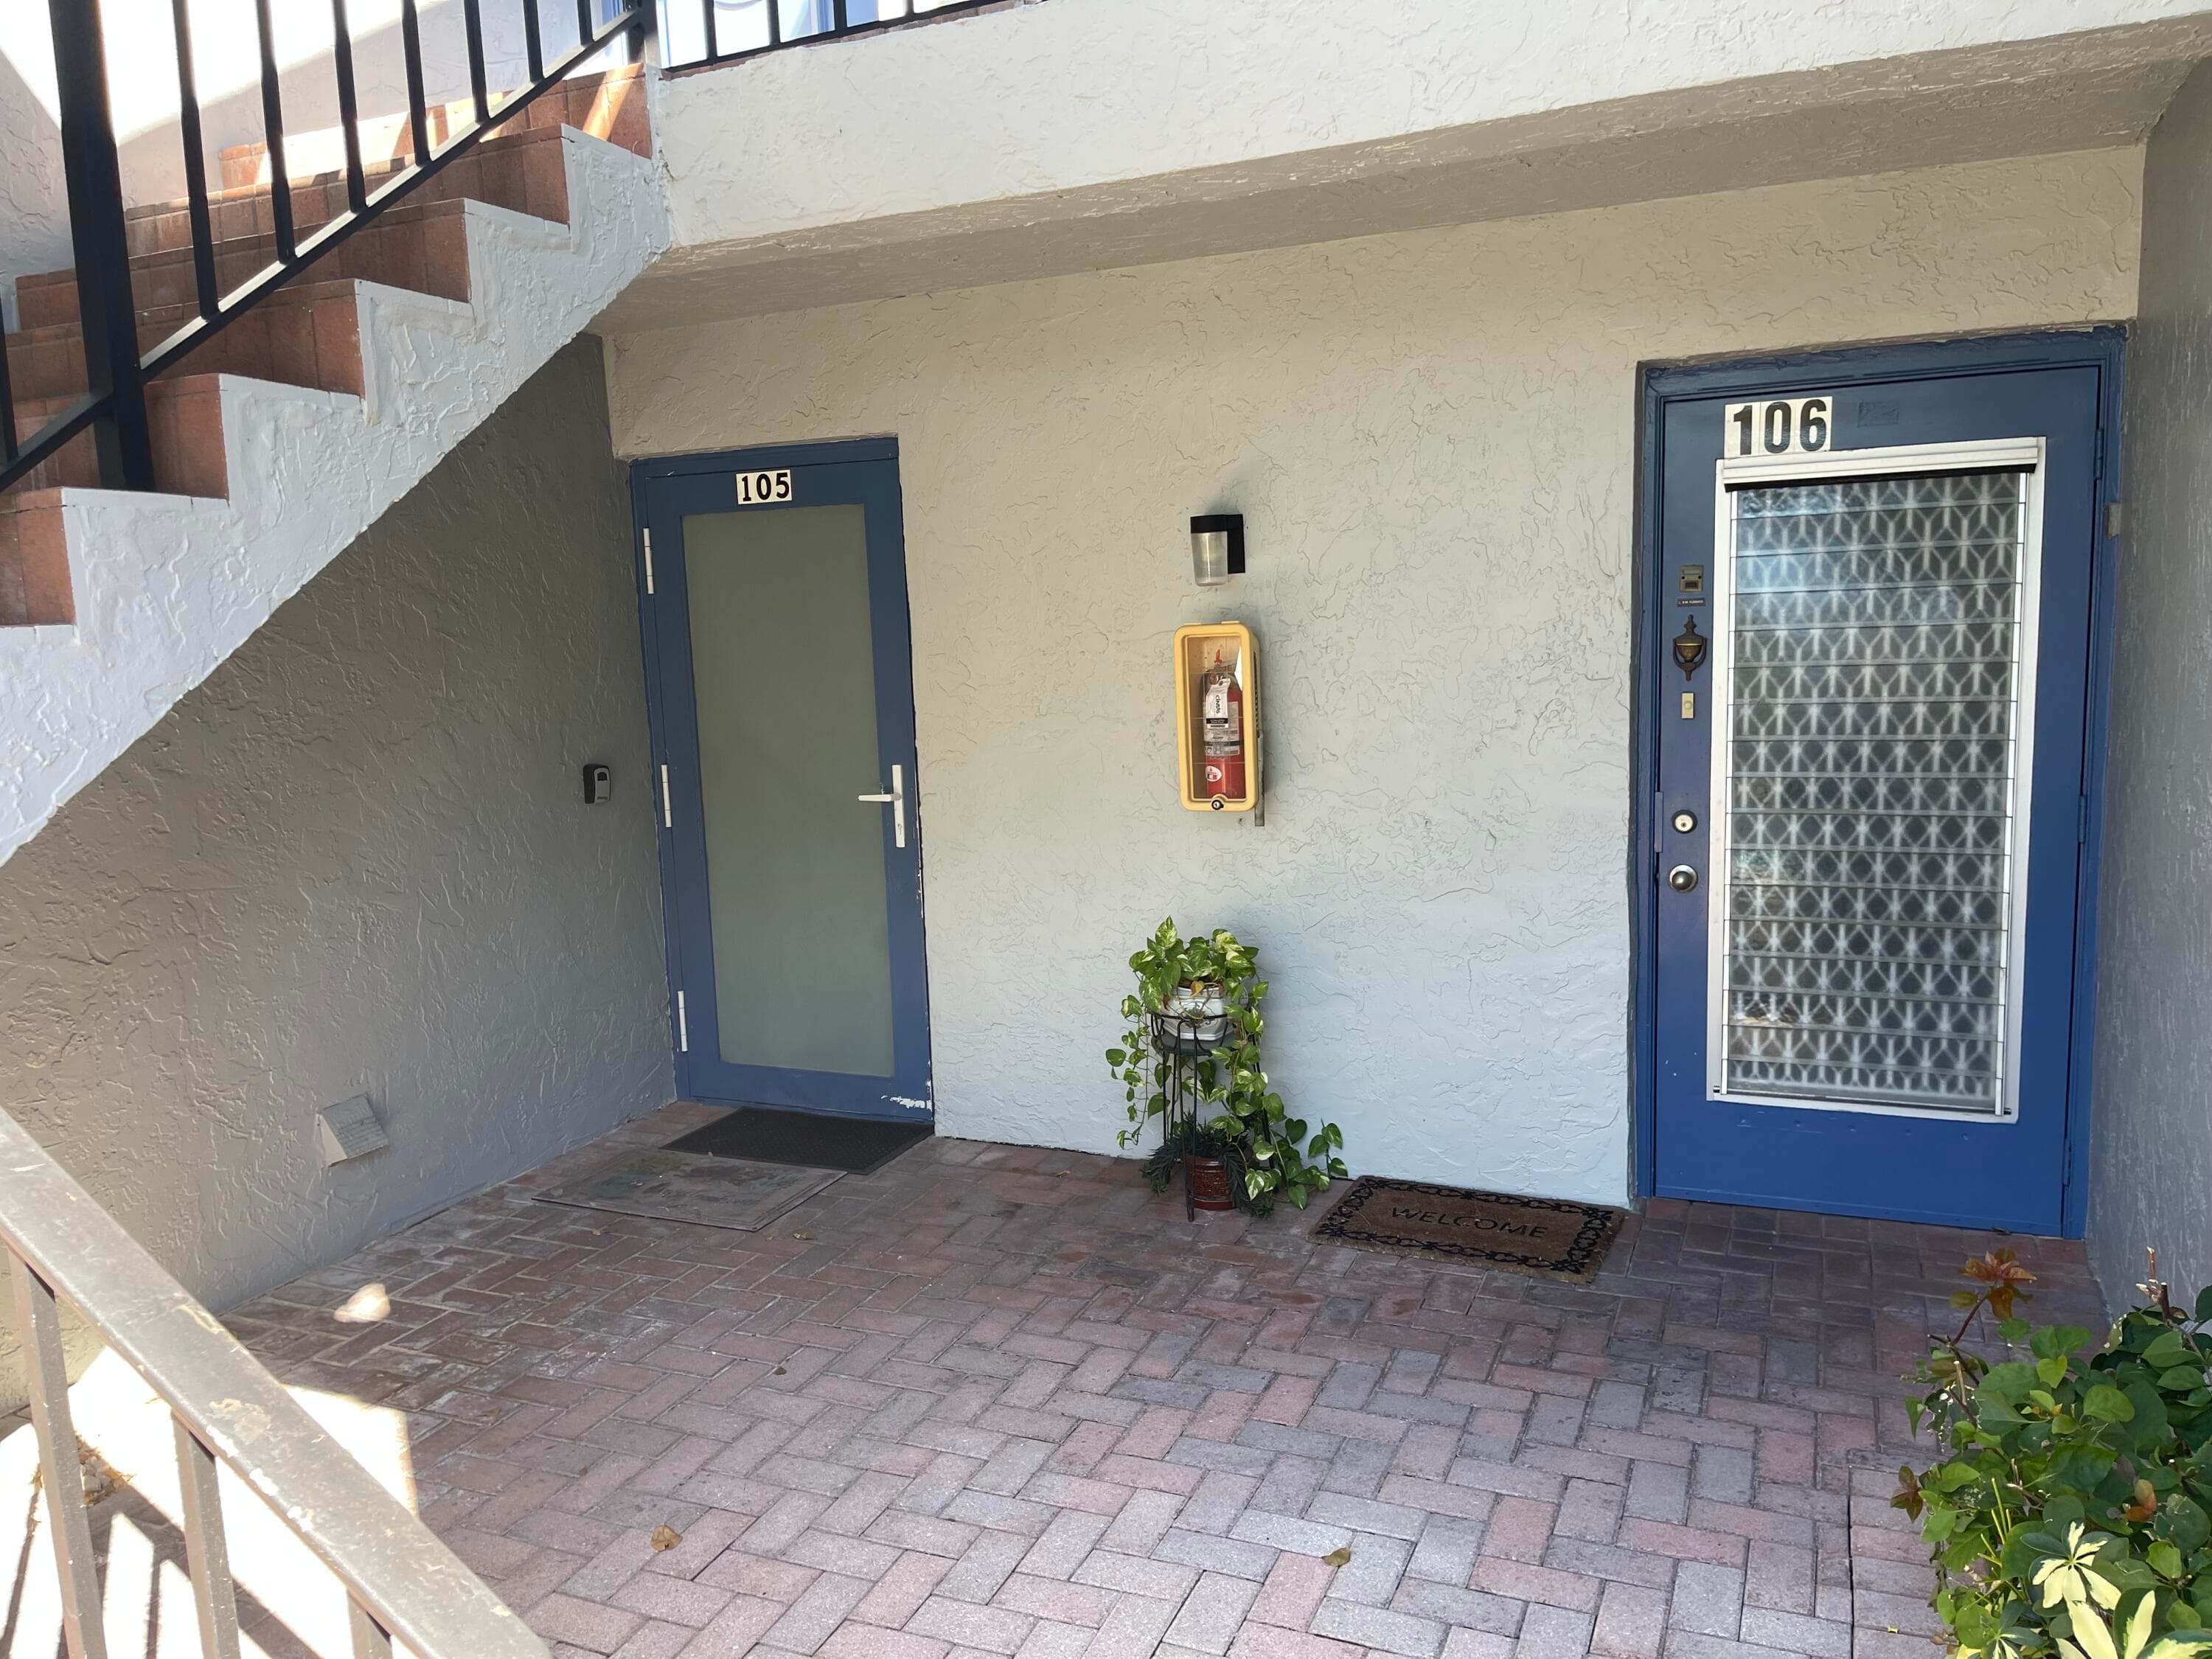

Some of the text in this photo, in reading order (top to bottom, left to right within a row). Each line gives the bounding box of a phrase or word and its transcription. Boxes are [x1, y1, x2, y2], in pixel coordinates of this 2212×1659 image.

[1733, 399, 1826, 455] 106
[742, 473, 789, 501] 105
[1391, 1207, 1548, 1239] WELCOME
